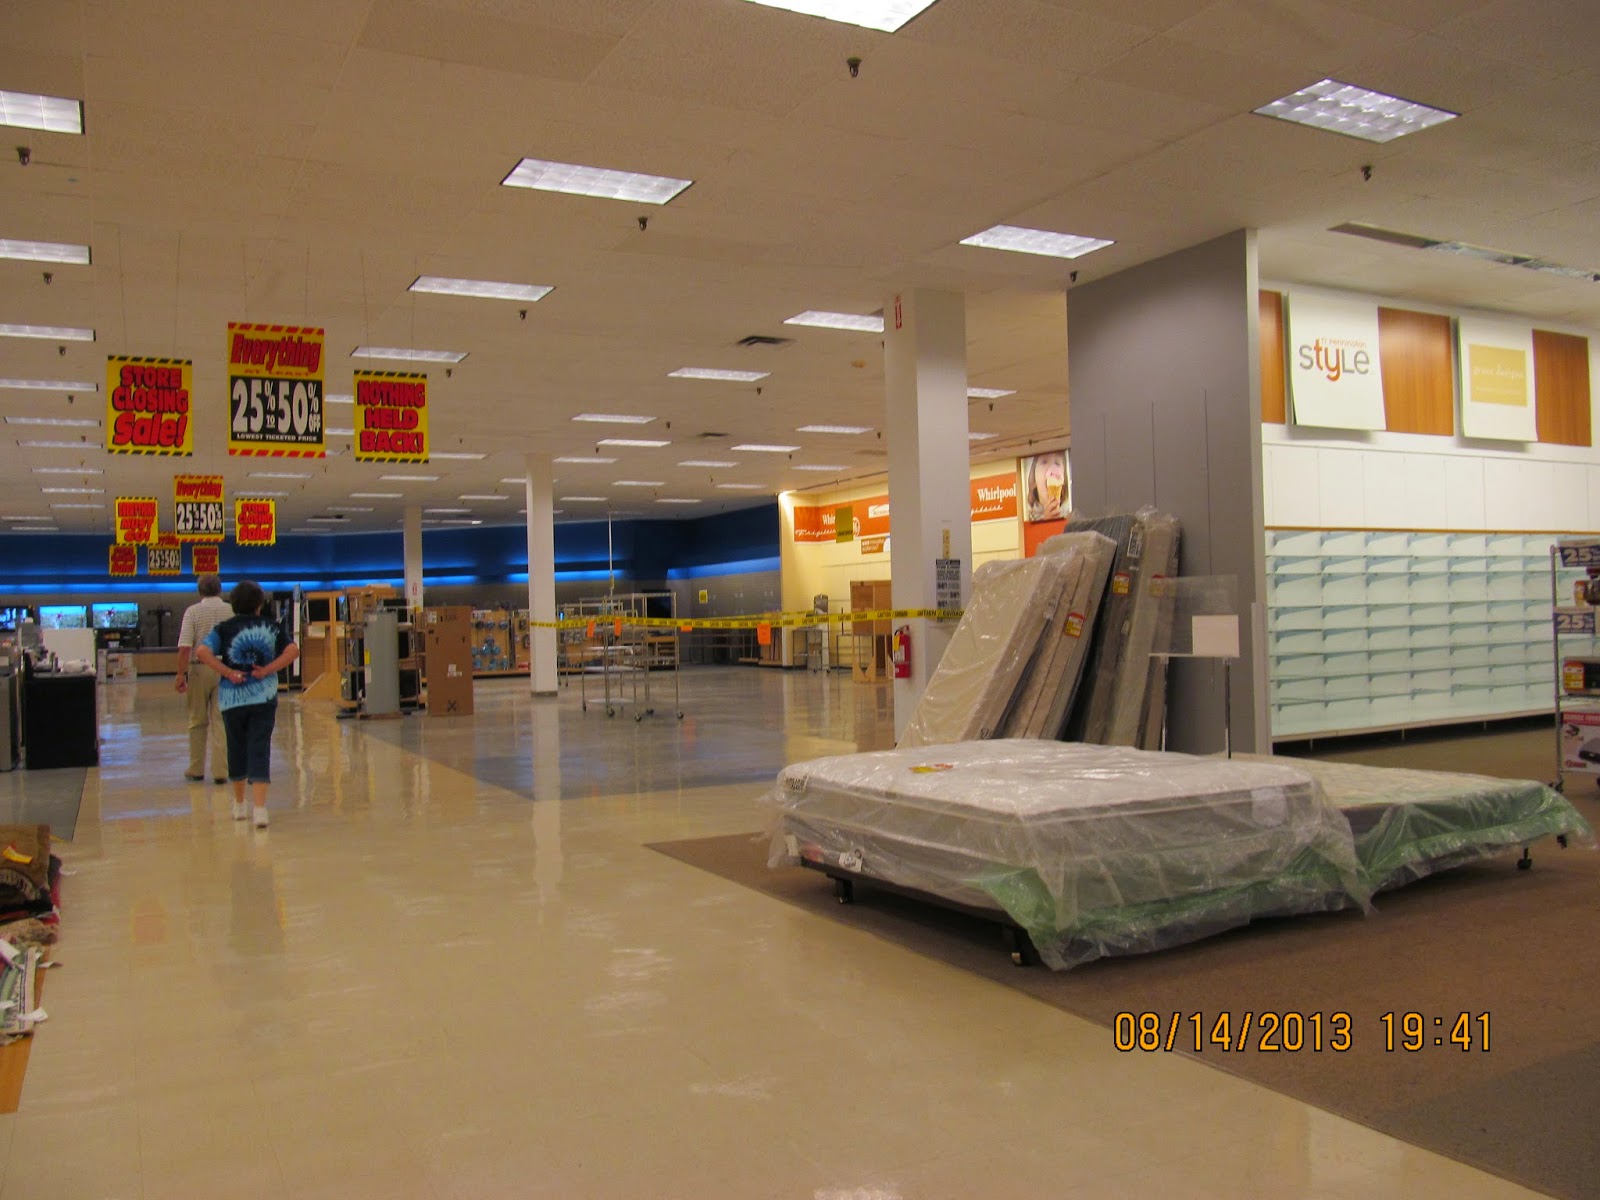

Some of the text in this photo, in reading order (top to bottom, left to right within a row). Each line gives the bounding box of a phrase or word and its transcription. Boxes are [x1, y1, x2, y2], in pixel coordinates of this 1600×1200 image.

[231, 333, 321, 373] Everything
[120, 364, 182, 389] STORE
[112, 386, 188, 414] CLOSING
[357, 379, 425, 408] NOTHING
[112, 411, 187, 448] Sale!
[308, 413, 320, 433] OFF
[364, 407, 419, 430] HELD
[360, 430, 424, 454] BACK!
[977, 483, 1016, 502] Whirlpool
